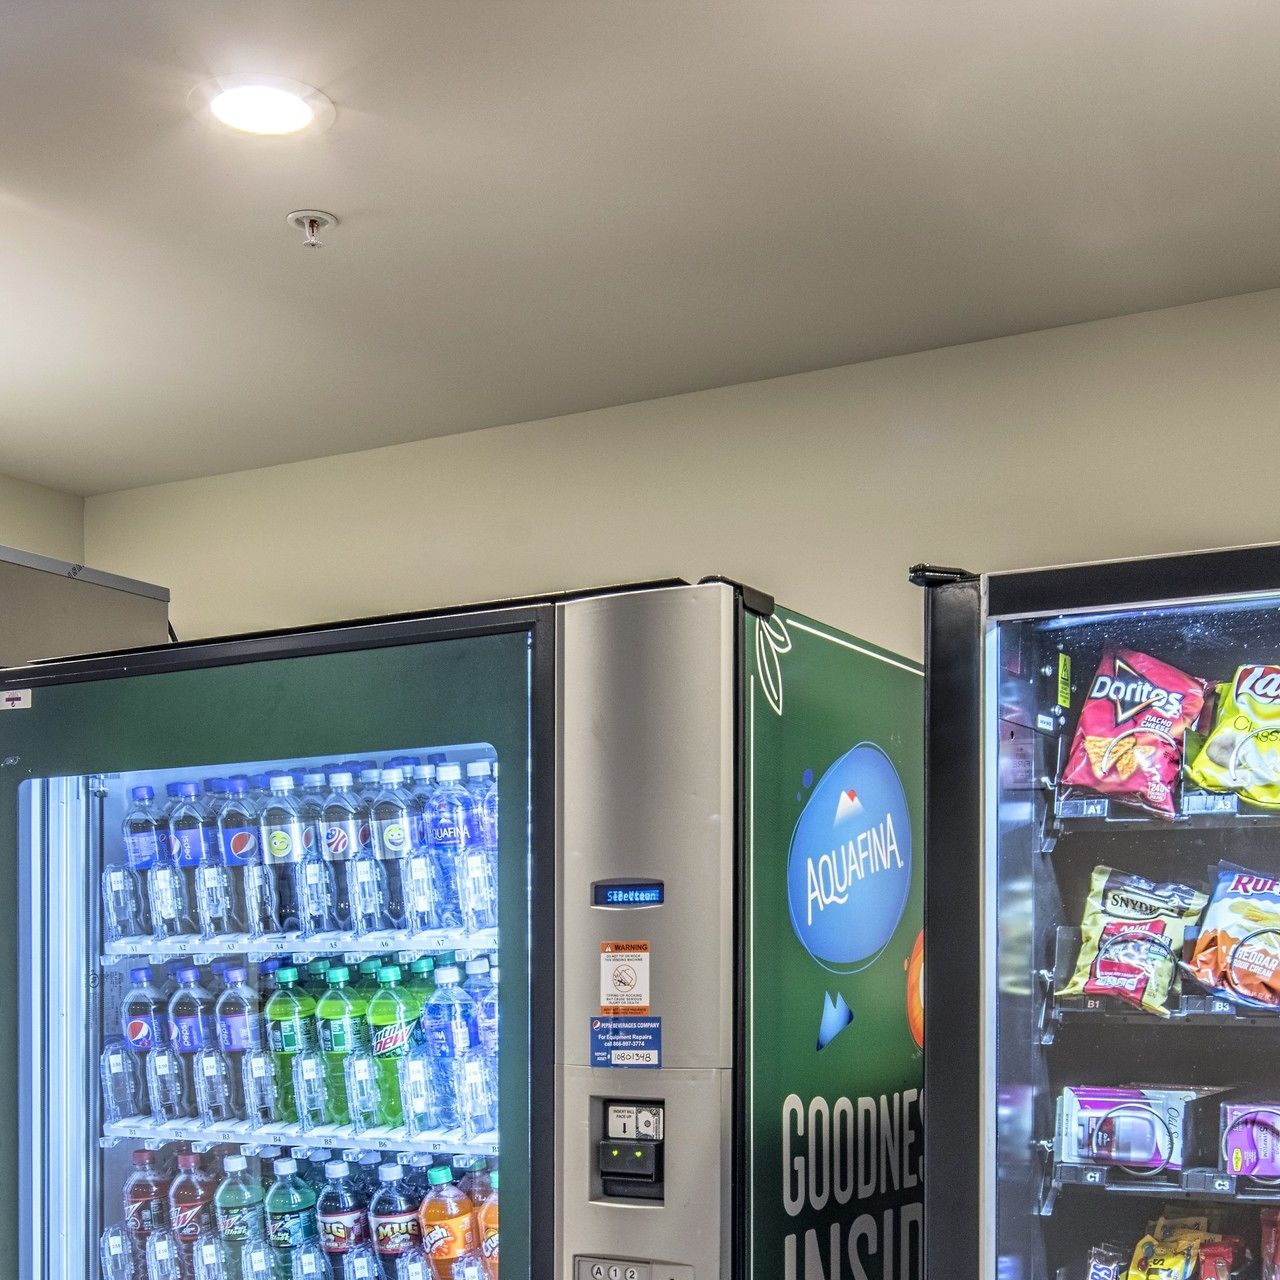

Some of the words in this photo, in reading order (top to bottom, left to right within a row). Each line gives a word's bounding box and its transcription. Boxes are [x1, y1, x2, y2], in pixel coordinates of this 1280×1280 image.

[1090, 676, 1184, 716] Doritos
[1144, 714, 1173, 728] NACHO
[1088, 805, 1101, 814] A1
[806, 811, 904, 927] AQUAFINA
[614, 943, 648, 951] WARNING
[1087, 1000, 1100, 1008] B1
[1216, 1002, 1230, 1011] B3
[614, 1052, 652, 1062] 10801348
[782, 1093, 923, 1217] GOODNE
[1086, 1172, 1100, 1182] C1
[1214, 1180, 1230, 1190] C3
[378, 1222, 418, 1240] MUG
